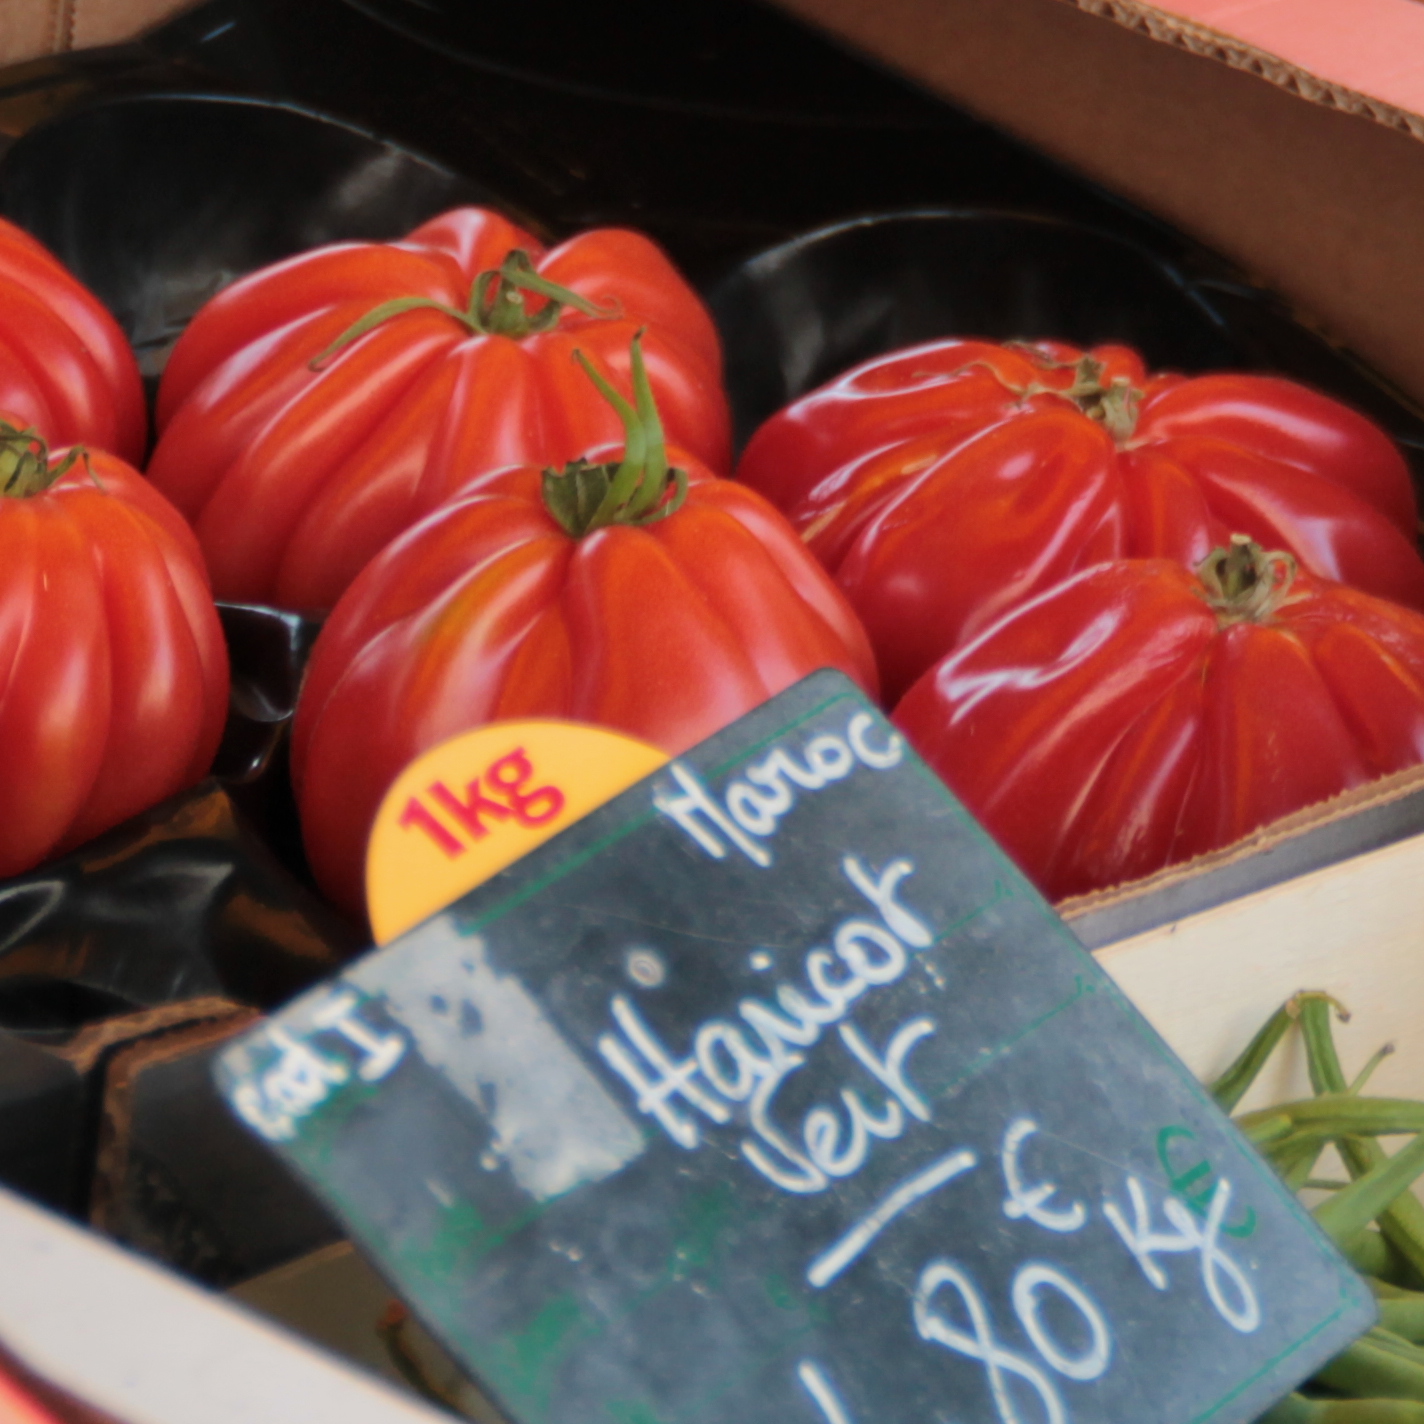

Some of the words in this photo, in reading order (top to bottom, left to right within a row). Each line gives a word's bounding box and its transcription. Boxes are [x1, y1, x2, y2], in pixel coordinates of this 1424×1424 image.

[399, 744, 566, 862] 1kg
[599, 855, 934, 1150] Haricot
[741, 1018, 938, 1194] Vert
